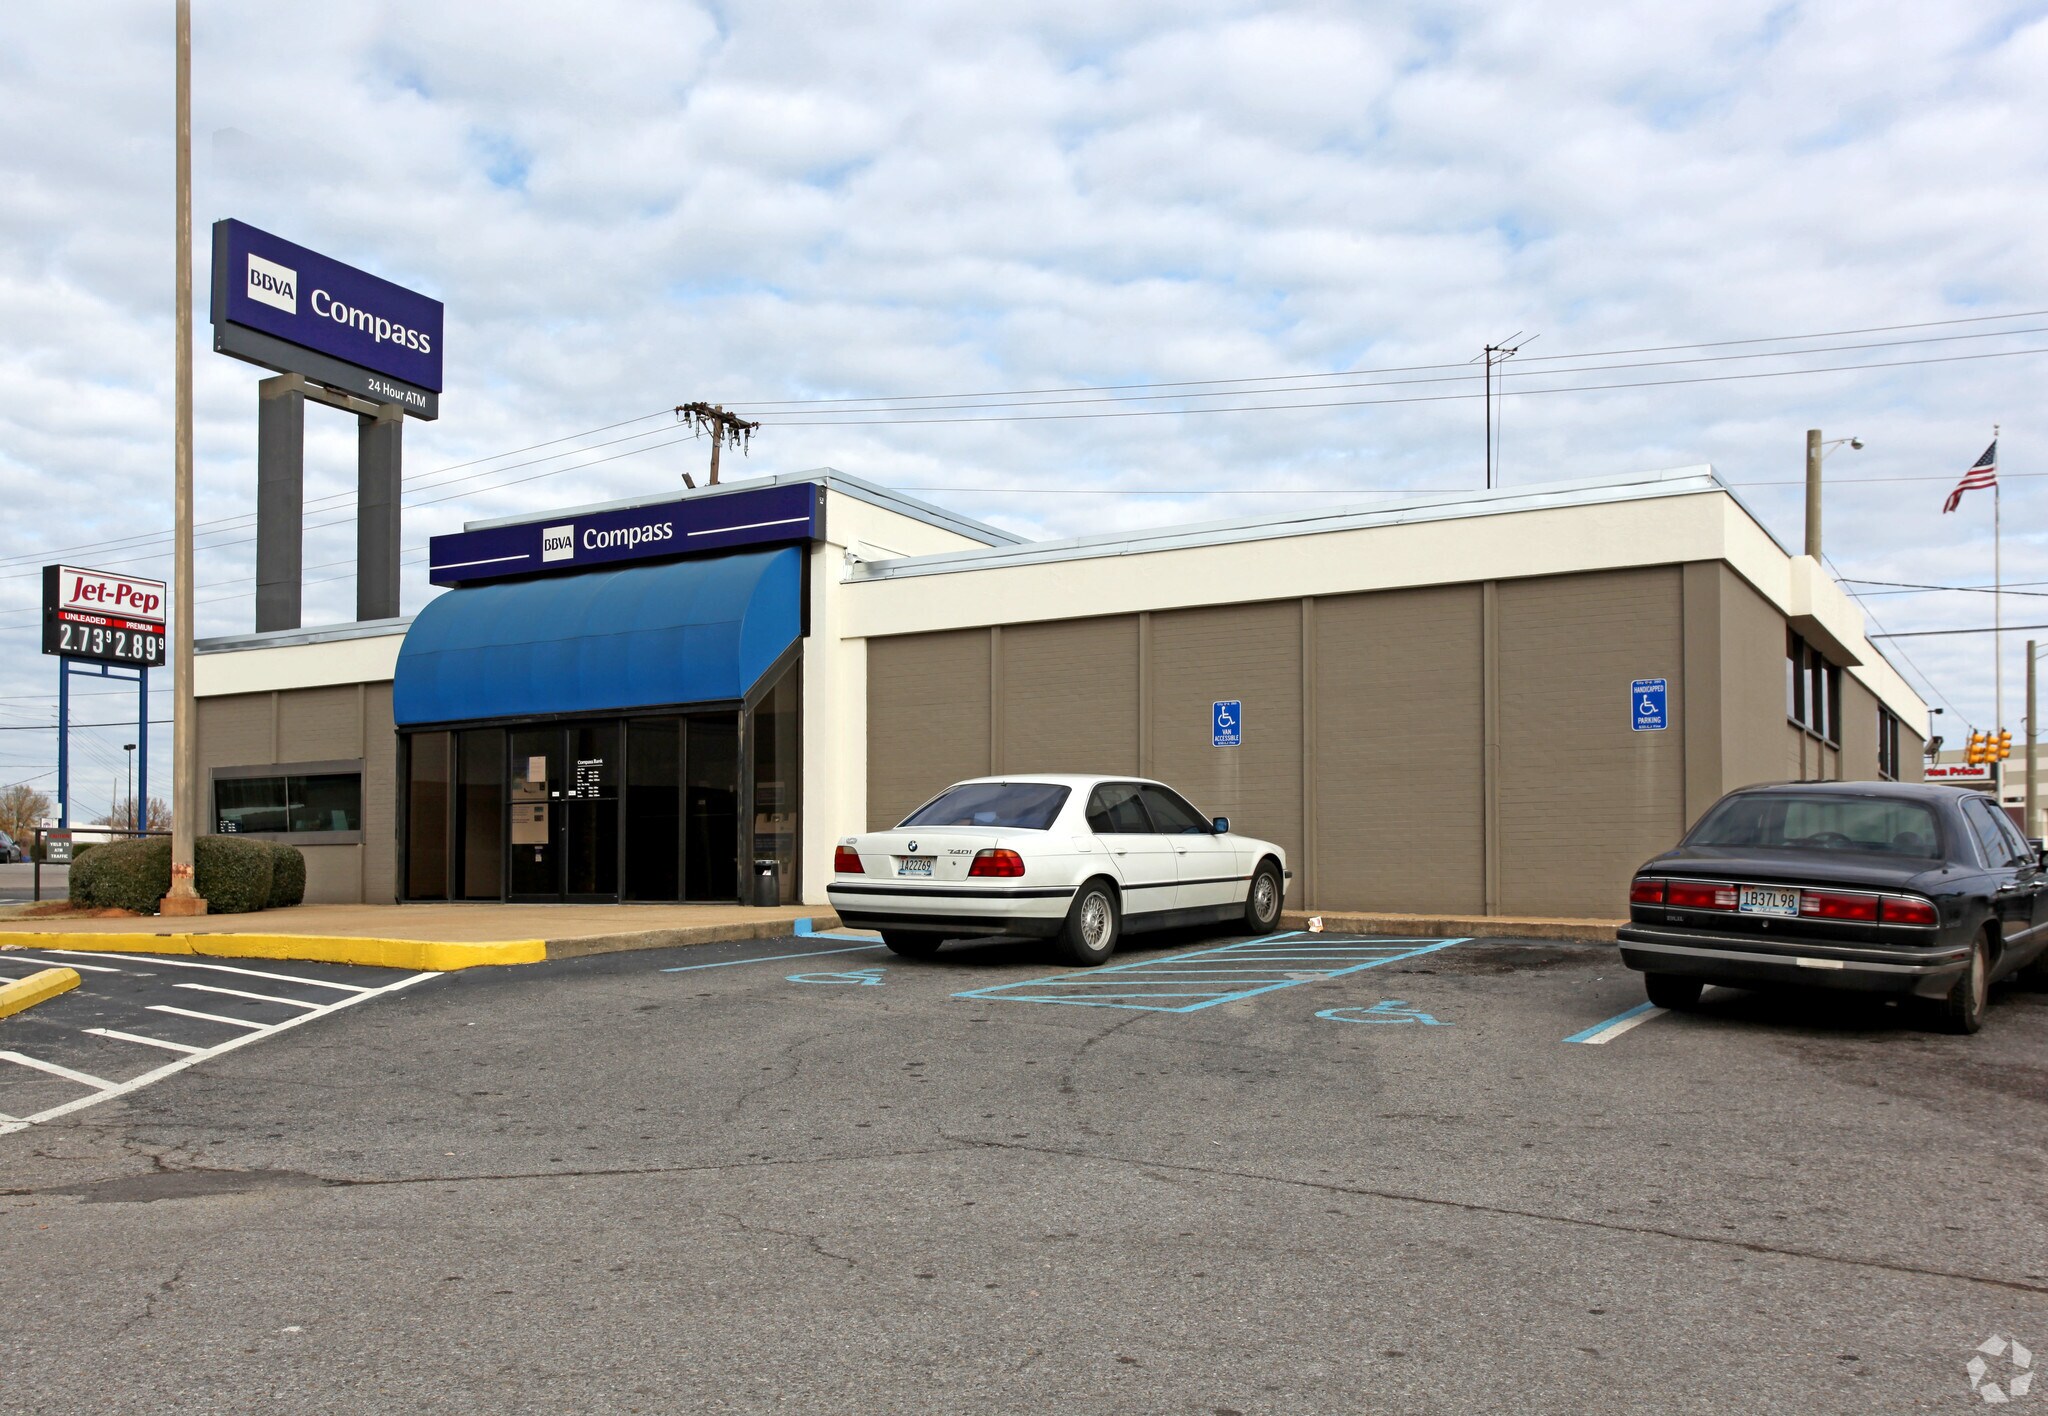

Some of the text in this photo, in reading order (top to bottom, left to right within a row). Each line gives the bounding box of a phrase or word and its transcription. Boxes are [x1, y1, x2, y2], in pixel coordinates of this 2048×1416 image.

[250, 269, 432, 354] BBVA Compass
[368, 378, 426, 408] 24 Hour ATM
[544, 522, 673, 552] BBVA Compass
[69, 576, 160, 614] Jet-Pep
[65, 613, 106, 625] UNLEADED
[126, 621, 153, 632] PREMIUM
[1634, 685, 1664, 693] HANDICAPPED
[1638, 716, 1661, 724] PARKING
[1950, 767, 1984, 775] Prices
[1743, 891, 1796, 909] 1B37L98
